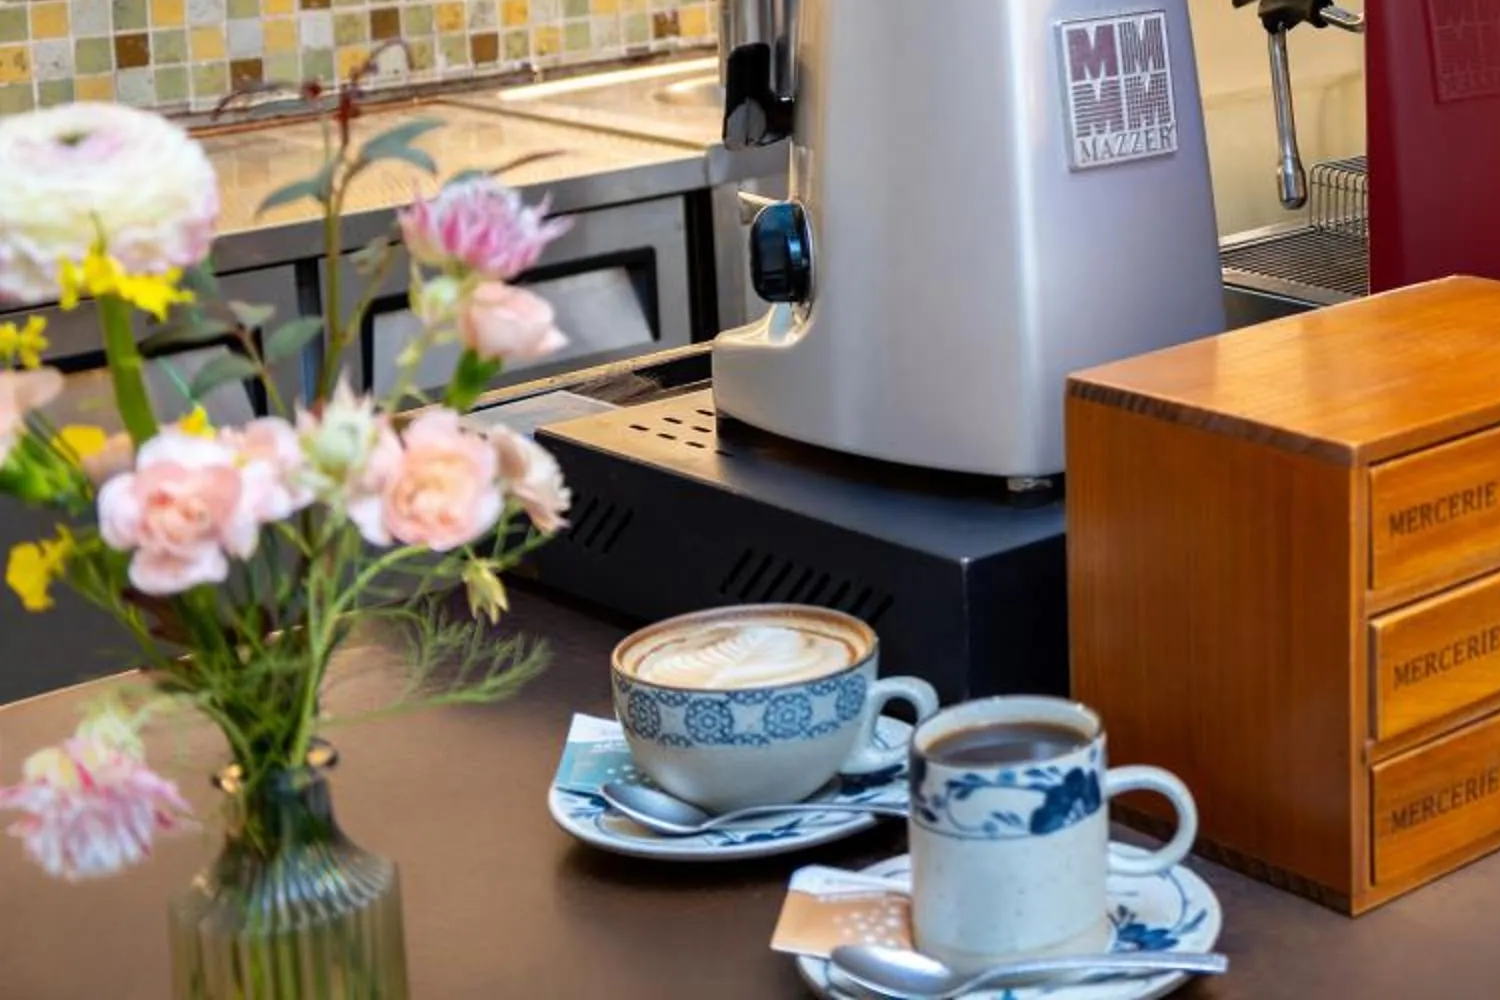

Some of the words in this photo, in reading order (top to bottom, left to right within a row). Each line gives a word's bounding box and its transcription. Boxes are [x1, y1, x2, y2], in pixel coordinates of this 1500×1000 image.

[1079, 126, 1176, 163] MAZZER
[1387, 481, 1498, 538] MERCERIE
[1389, 770, 1500, 833] MERCERIE
